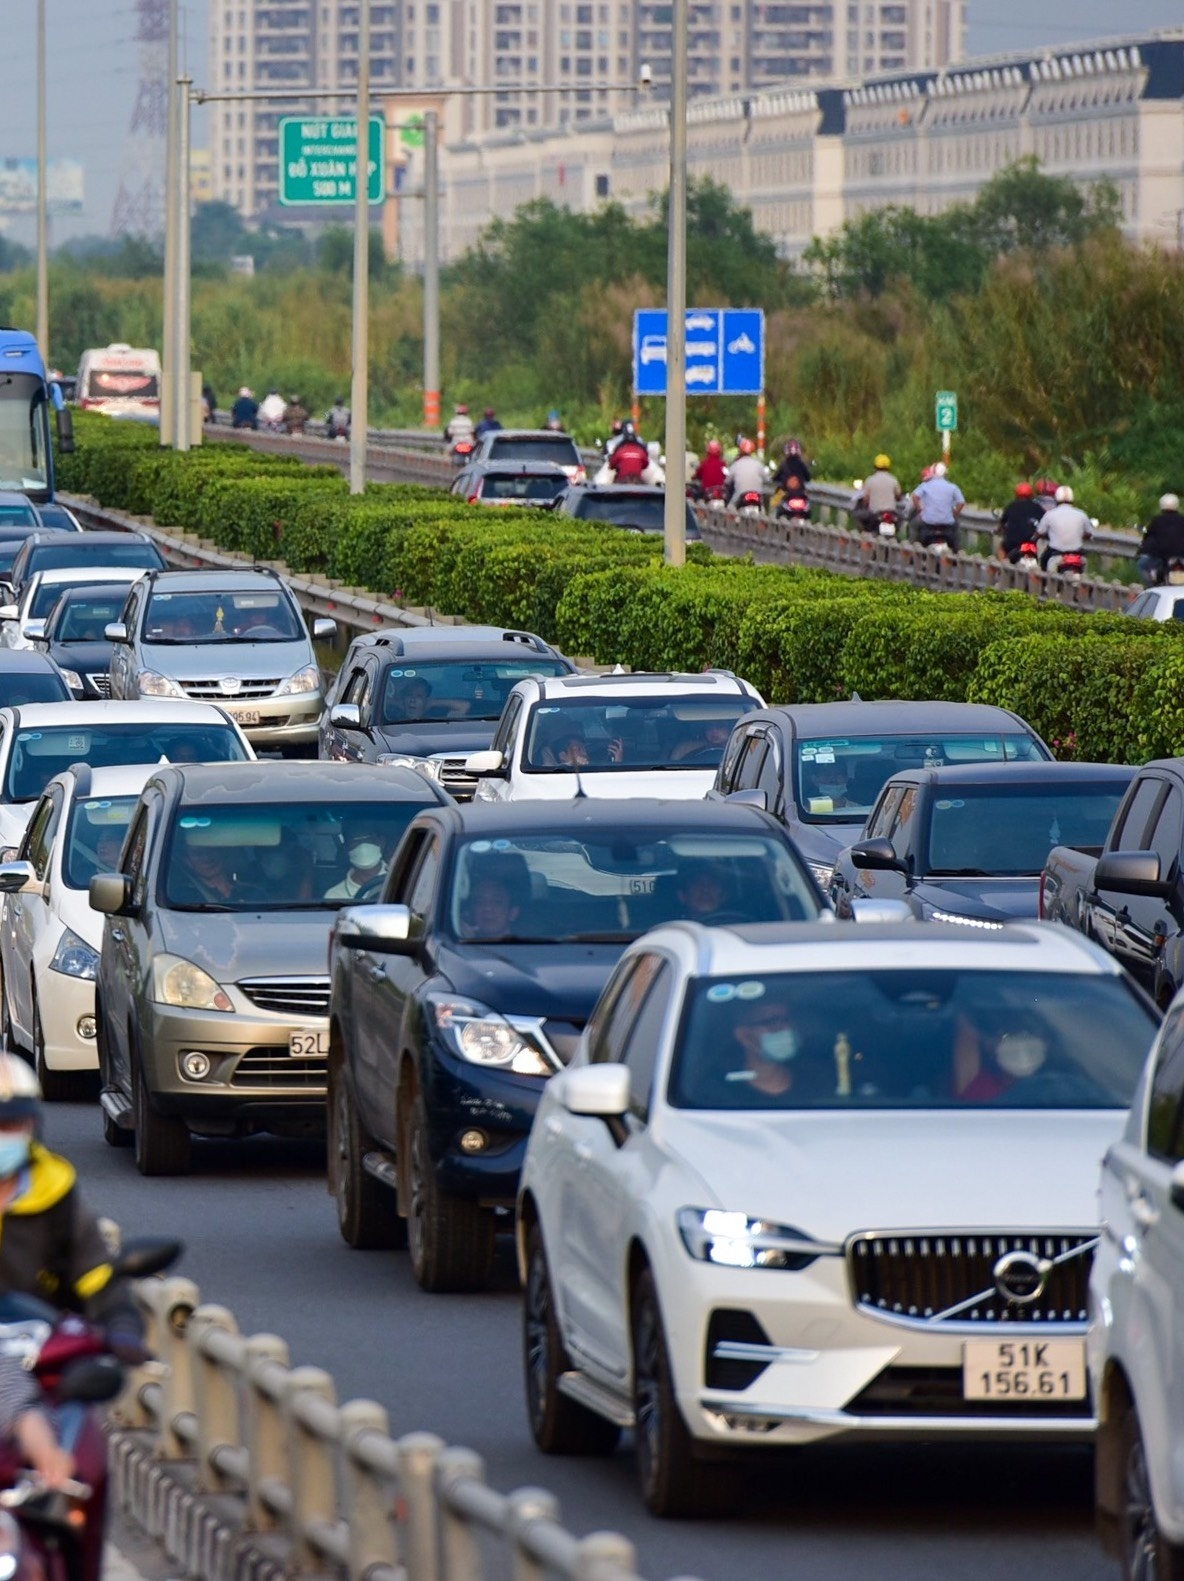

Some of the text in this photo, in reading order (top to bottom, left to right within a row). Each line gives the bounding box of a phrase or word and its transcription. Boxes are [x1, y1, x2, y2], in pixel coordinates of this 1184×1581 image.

[330, 122, 357, 139] GIA
[348, 160, 377, 177] HP
[312, 180, 352, 197] 500 M
[941, 408, 952, 425] 2
[229, 711, 257, 722] 95.94
[291, 1033, 329, 1054] 52L
[999, 1343, 1049, 1367] 51K
[981, 1372, 1071, 1395] 156.61
